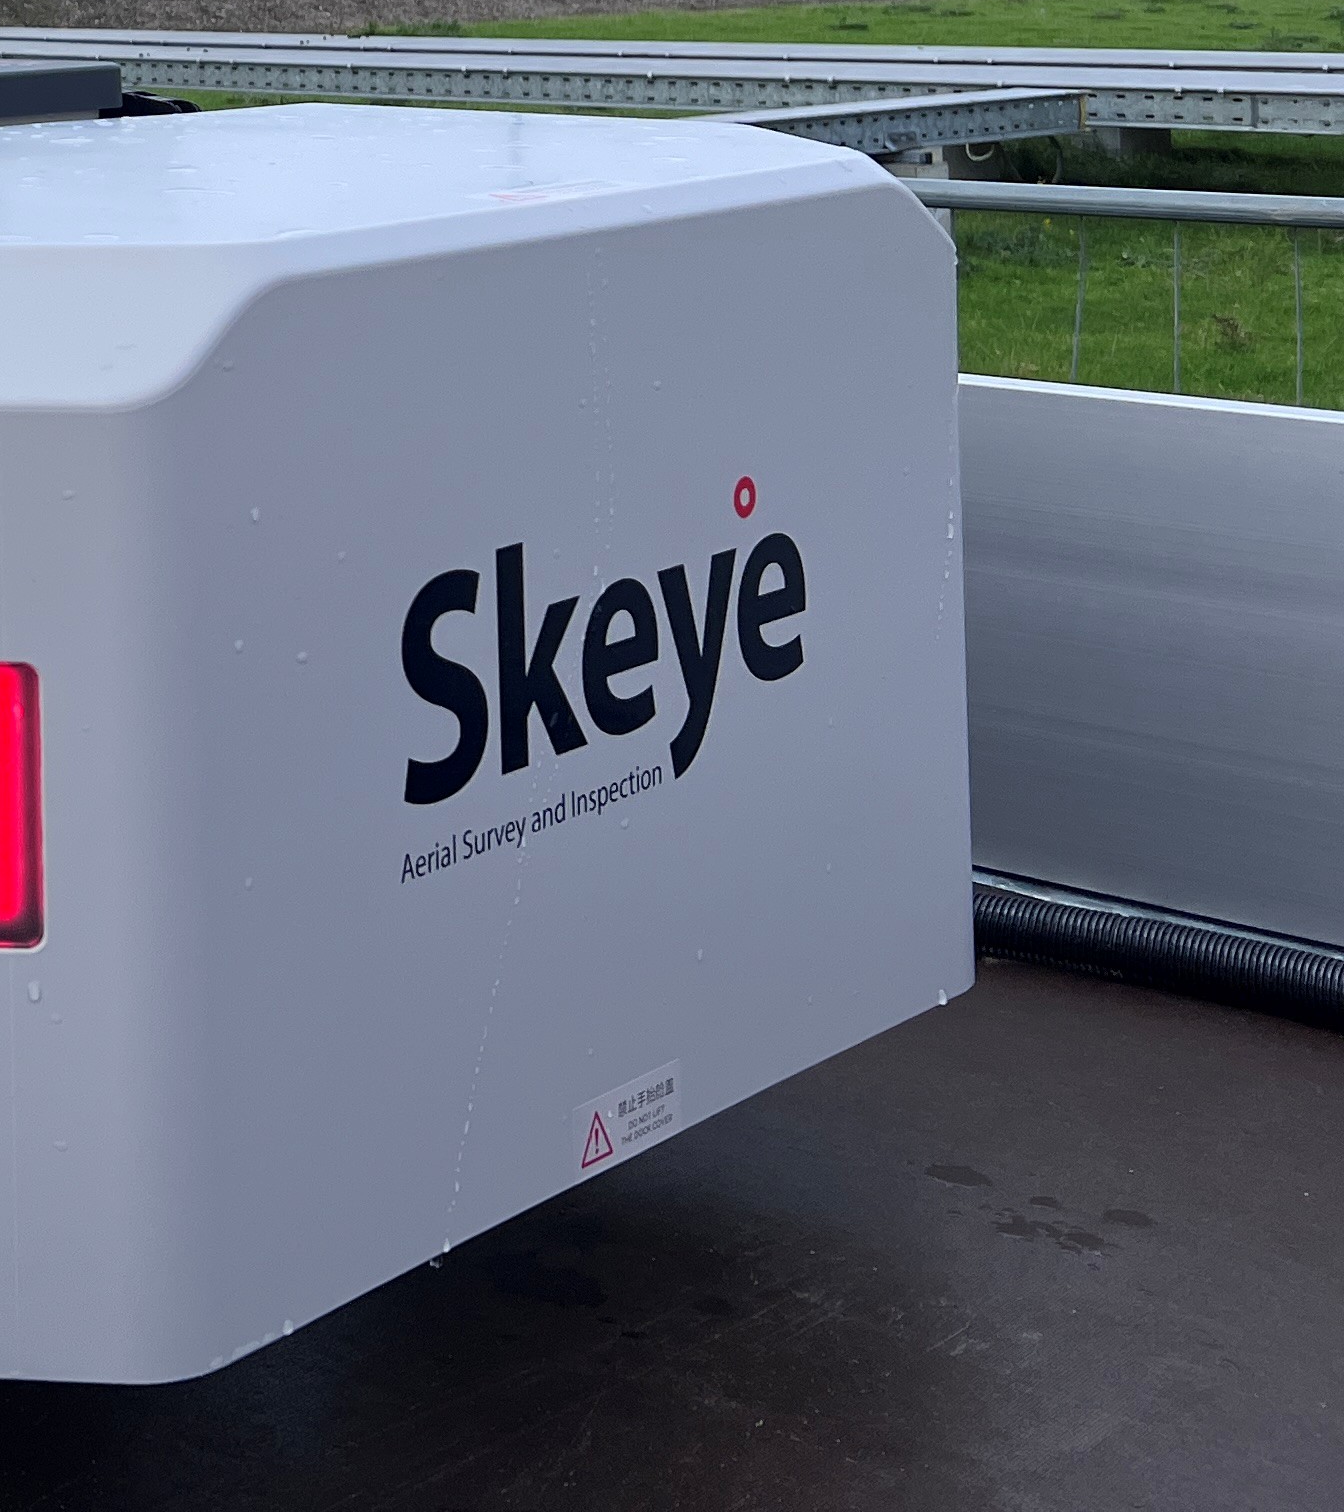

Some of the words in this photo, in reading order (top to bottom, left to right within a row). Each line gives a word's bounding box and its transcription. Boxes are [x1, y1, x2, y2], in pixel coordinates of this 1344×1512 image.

[401, 533, 807, 805] Skeye
[401, 834, 457, 884] Aerial
[462, 815, 527, 861] Survey
[531, 792, 567, 834] and
[570, 763, 663, 821] Inspection
